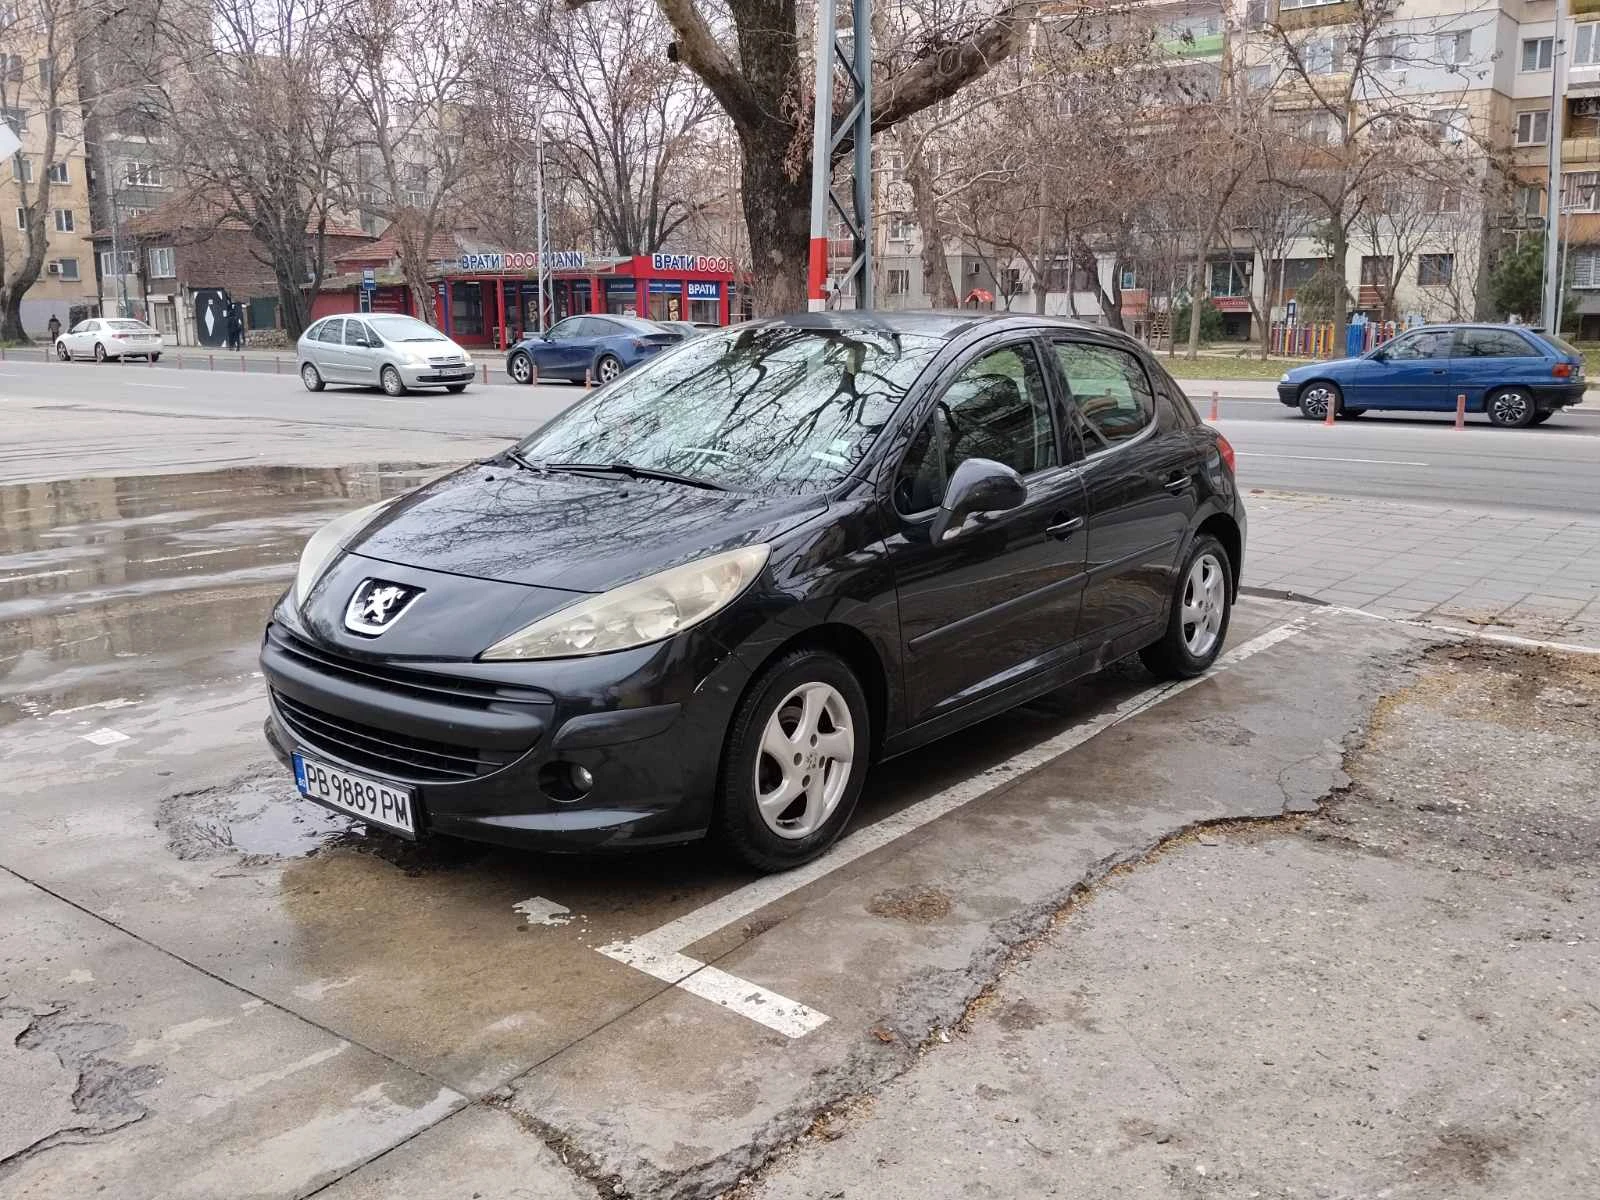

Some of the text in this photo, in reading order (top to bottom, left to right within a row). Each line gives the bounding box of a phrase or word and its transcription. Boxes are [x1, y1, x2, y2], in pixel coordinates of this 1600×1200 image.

[461, 254, 501, 270] ВРАТИ
[653, 253, 695, 271] ВРАТИ
[688, 283, 716, 295] ВРАТИ
